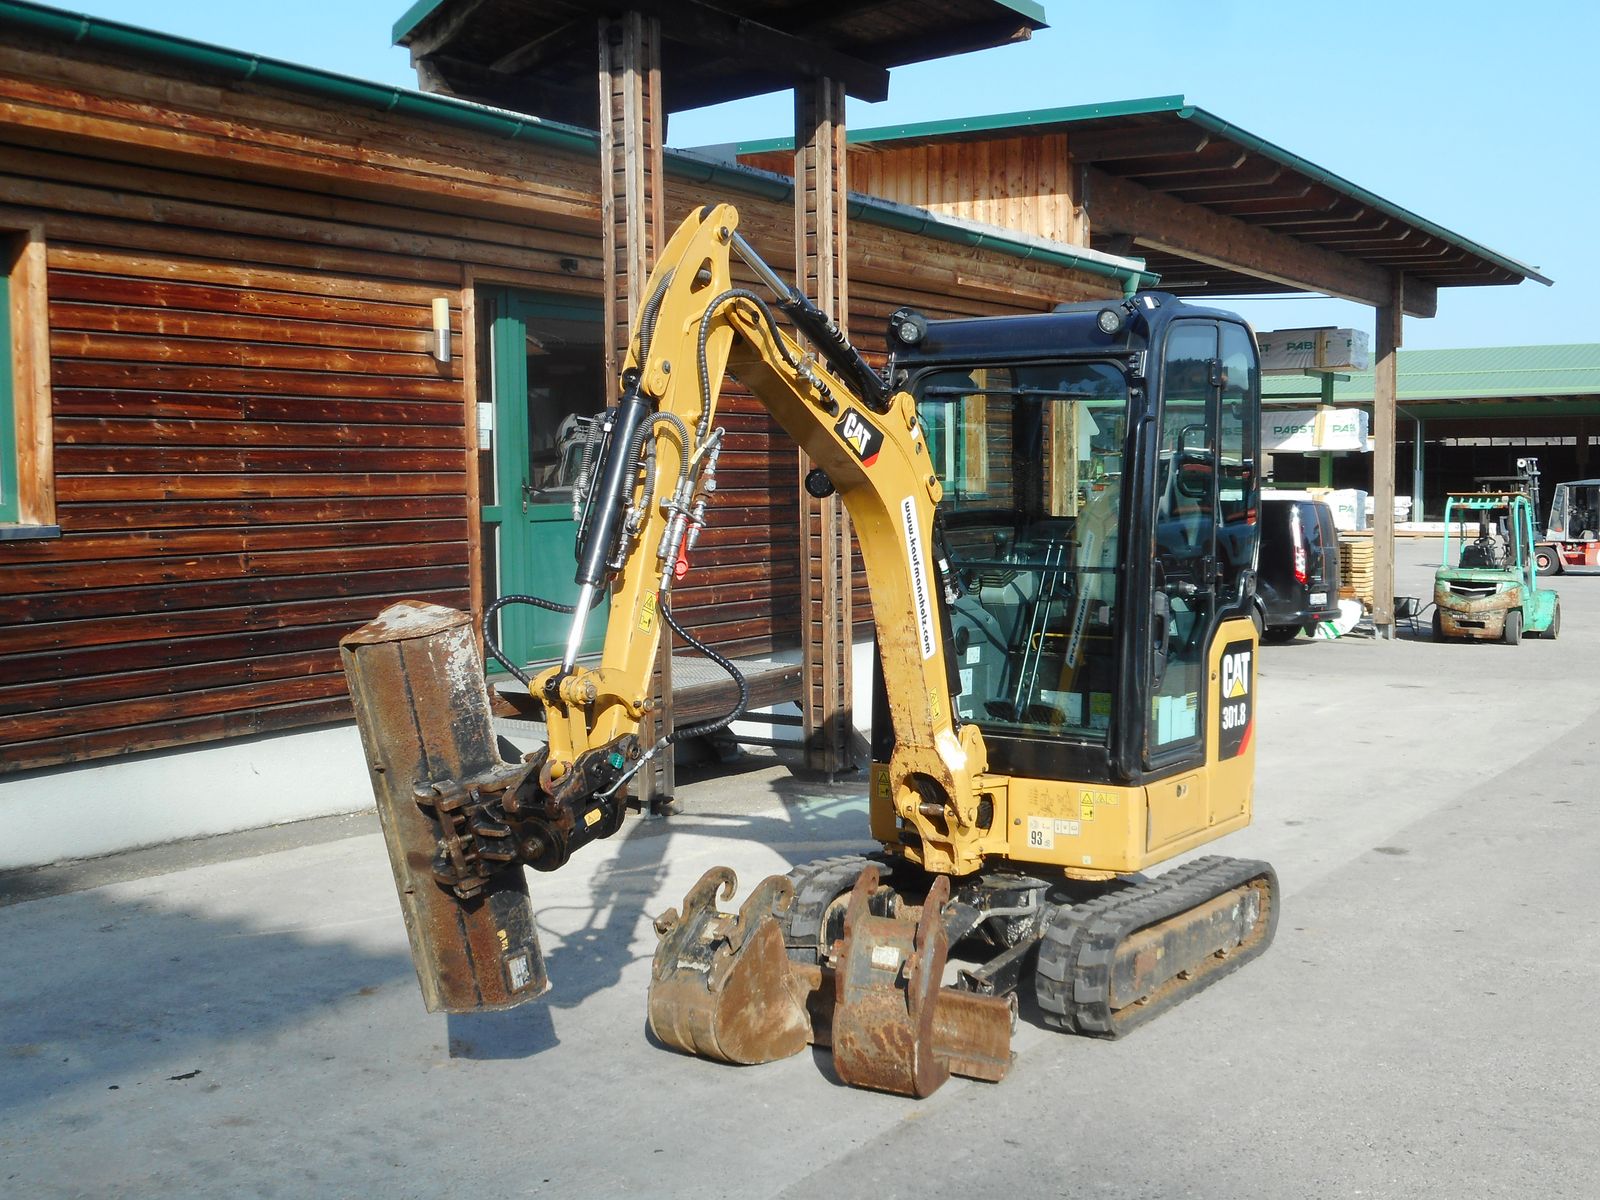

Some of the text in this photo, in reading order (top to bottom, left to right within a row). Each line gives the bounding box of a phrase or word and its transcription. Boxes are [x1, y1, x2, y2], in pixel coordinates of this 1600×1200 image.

[843, 412, 872, 456] CAT
[904, 501, 931, 654] www.kaufmannholz.com
[1222, 651, 1250, 698] CAT
[1222, 702, 1246, 730] 301.8
[1031, 830, 1042, 845] 93
